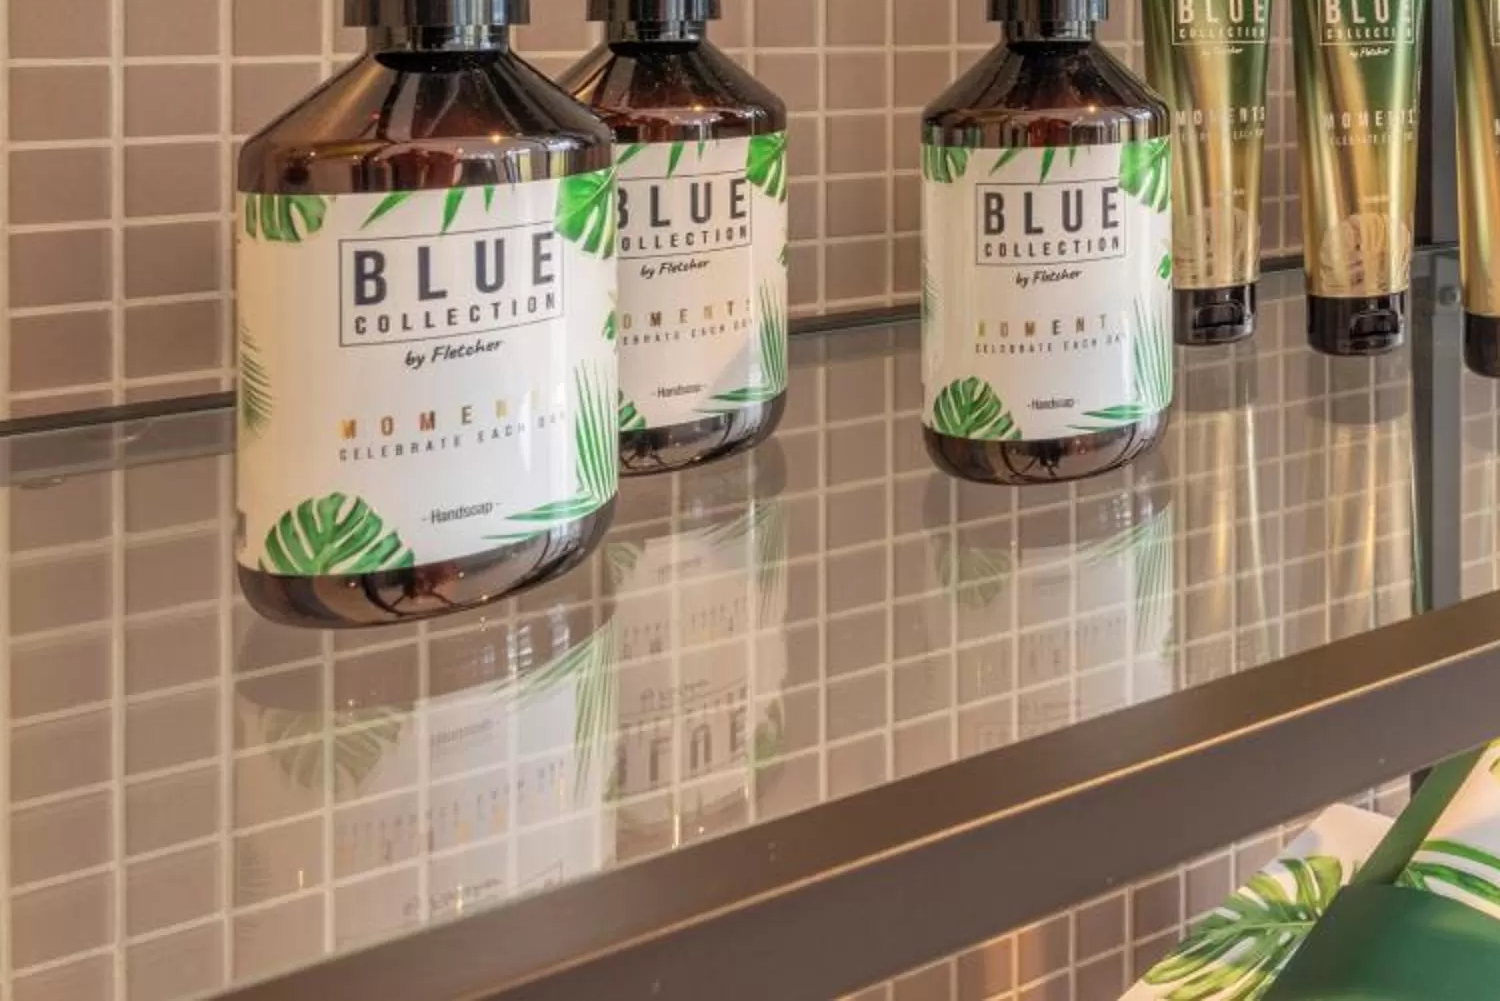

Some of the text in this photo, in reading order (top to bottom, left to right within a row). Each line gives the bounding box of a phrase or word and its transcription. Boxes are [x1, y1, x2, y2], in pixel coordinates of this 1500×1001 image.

[983, 186, 1120, 236] BLUE
[621, 225, 747, 251] OLLECTION
[984, 236, 1120, 259] COLLECTION
[353, 230, 556, 307] BLUE
[640, 258, 711, 280] by Fletcher
[1015, 272, 1030, 289] by
[354, 291, 556, 336] COLLECTION
[404, 339, 506, 371] by Fletcher
[338, 433, 464, 462] CELEBRATE
